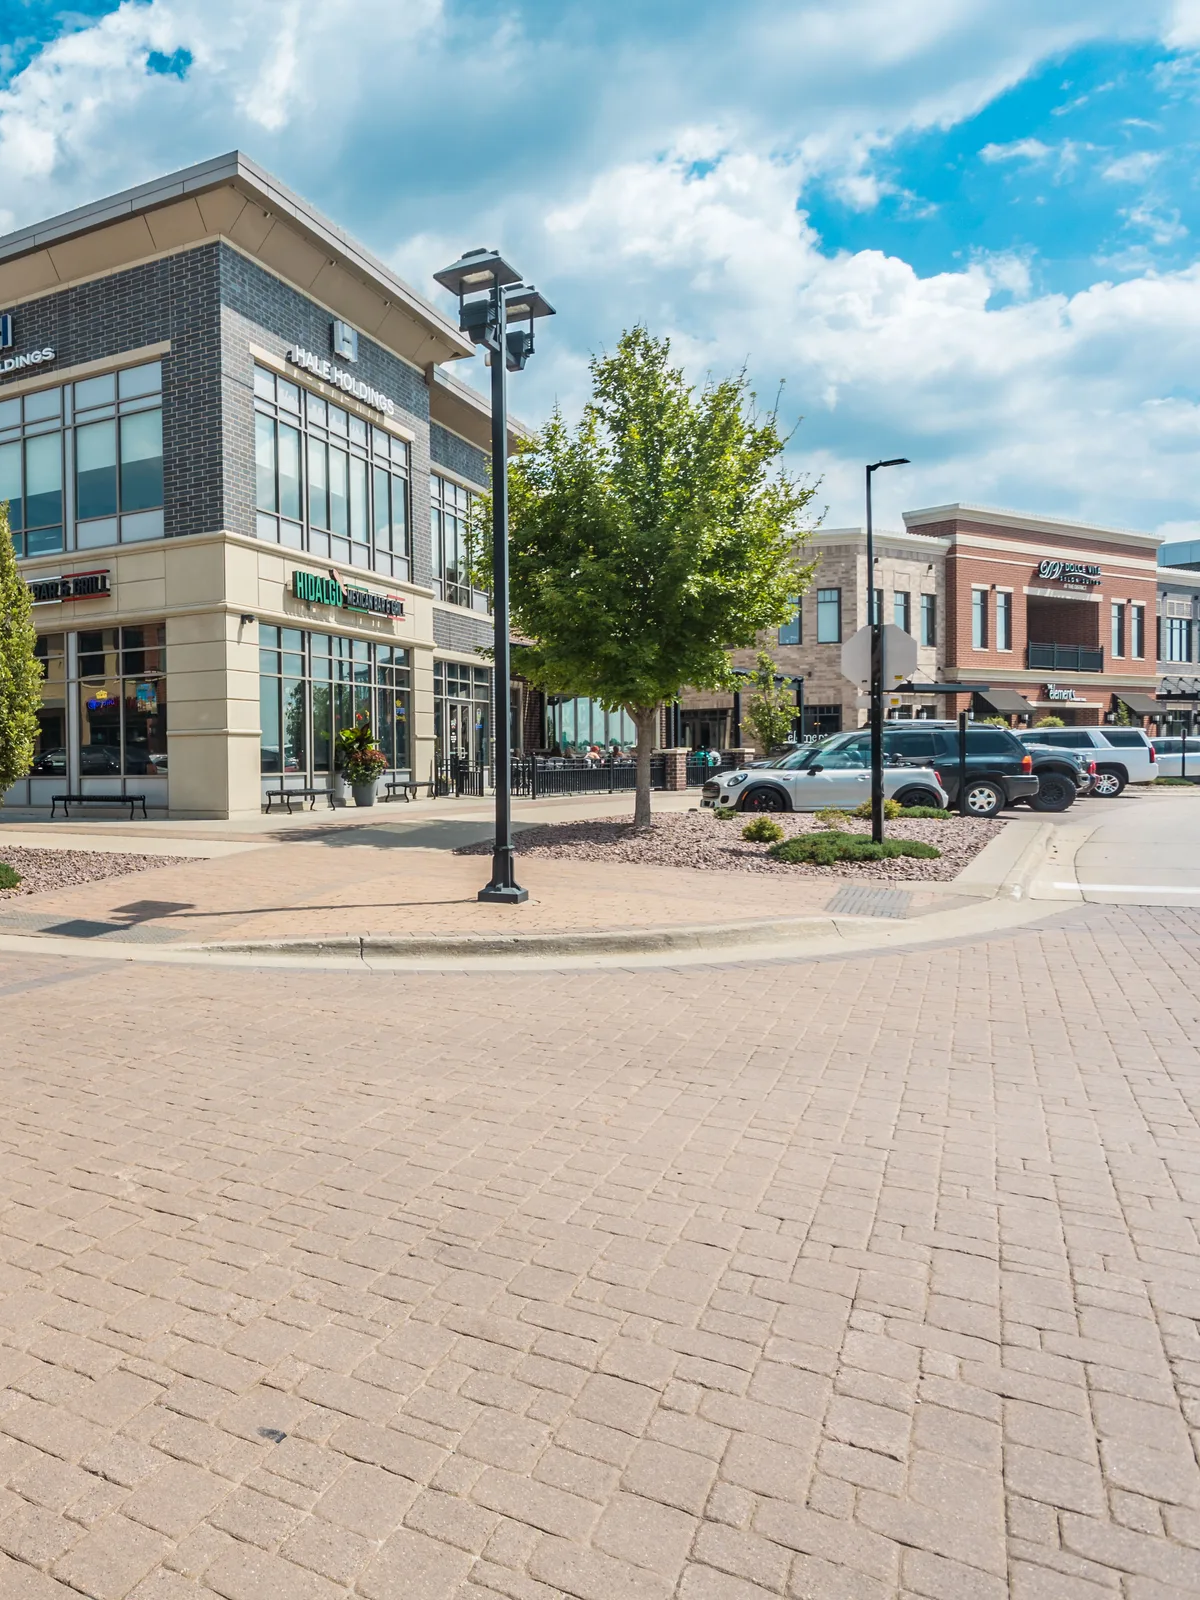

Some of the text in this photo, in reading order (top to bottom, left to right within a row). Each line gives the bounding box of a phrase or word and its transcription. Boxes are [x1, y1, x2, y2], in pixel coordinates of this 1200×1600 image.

[291, 344, 394, 415] HALE HOLDINGS
[1064, 562, 1086, 573] DOLCE
[32, 575, 110, 600] BAR & GRILL
[296, 570, 344, 608] HIDALGO
[347, 589, 373, 610] MEXICAN
